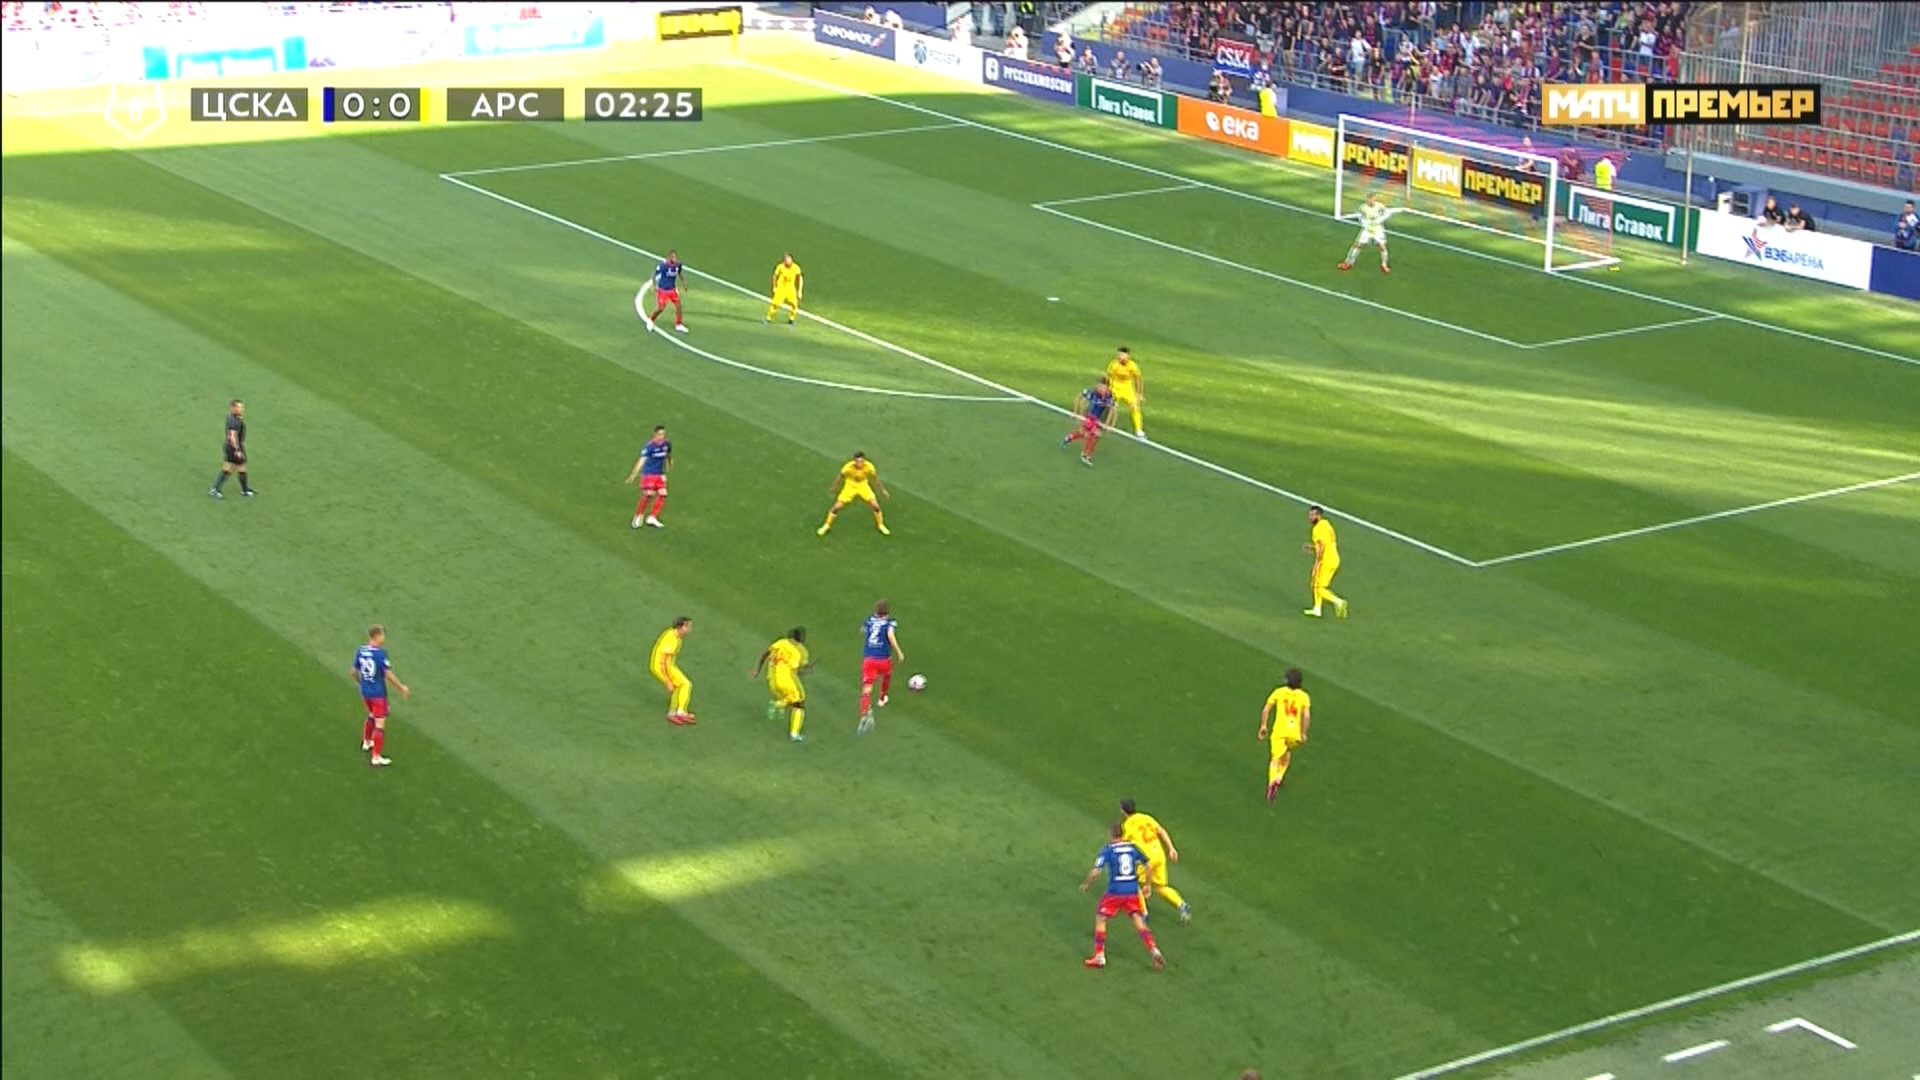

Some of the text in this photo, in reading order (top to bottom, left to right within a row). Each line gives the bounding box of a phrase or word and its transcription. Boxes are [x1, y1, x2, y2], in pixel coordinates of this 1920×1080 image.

[1217, 45, 1251, 69] CSKA
[1417, 157, 1542, 204] МАТЧ ПРЕМЬЕР
[1579, 204, 1663, 241] Лига Ставок
[1283, 699, 1298, 718] 14
[1119, 853, 1132, 875] 8
